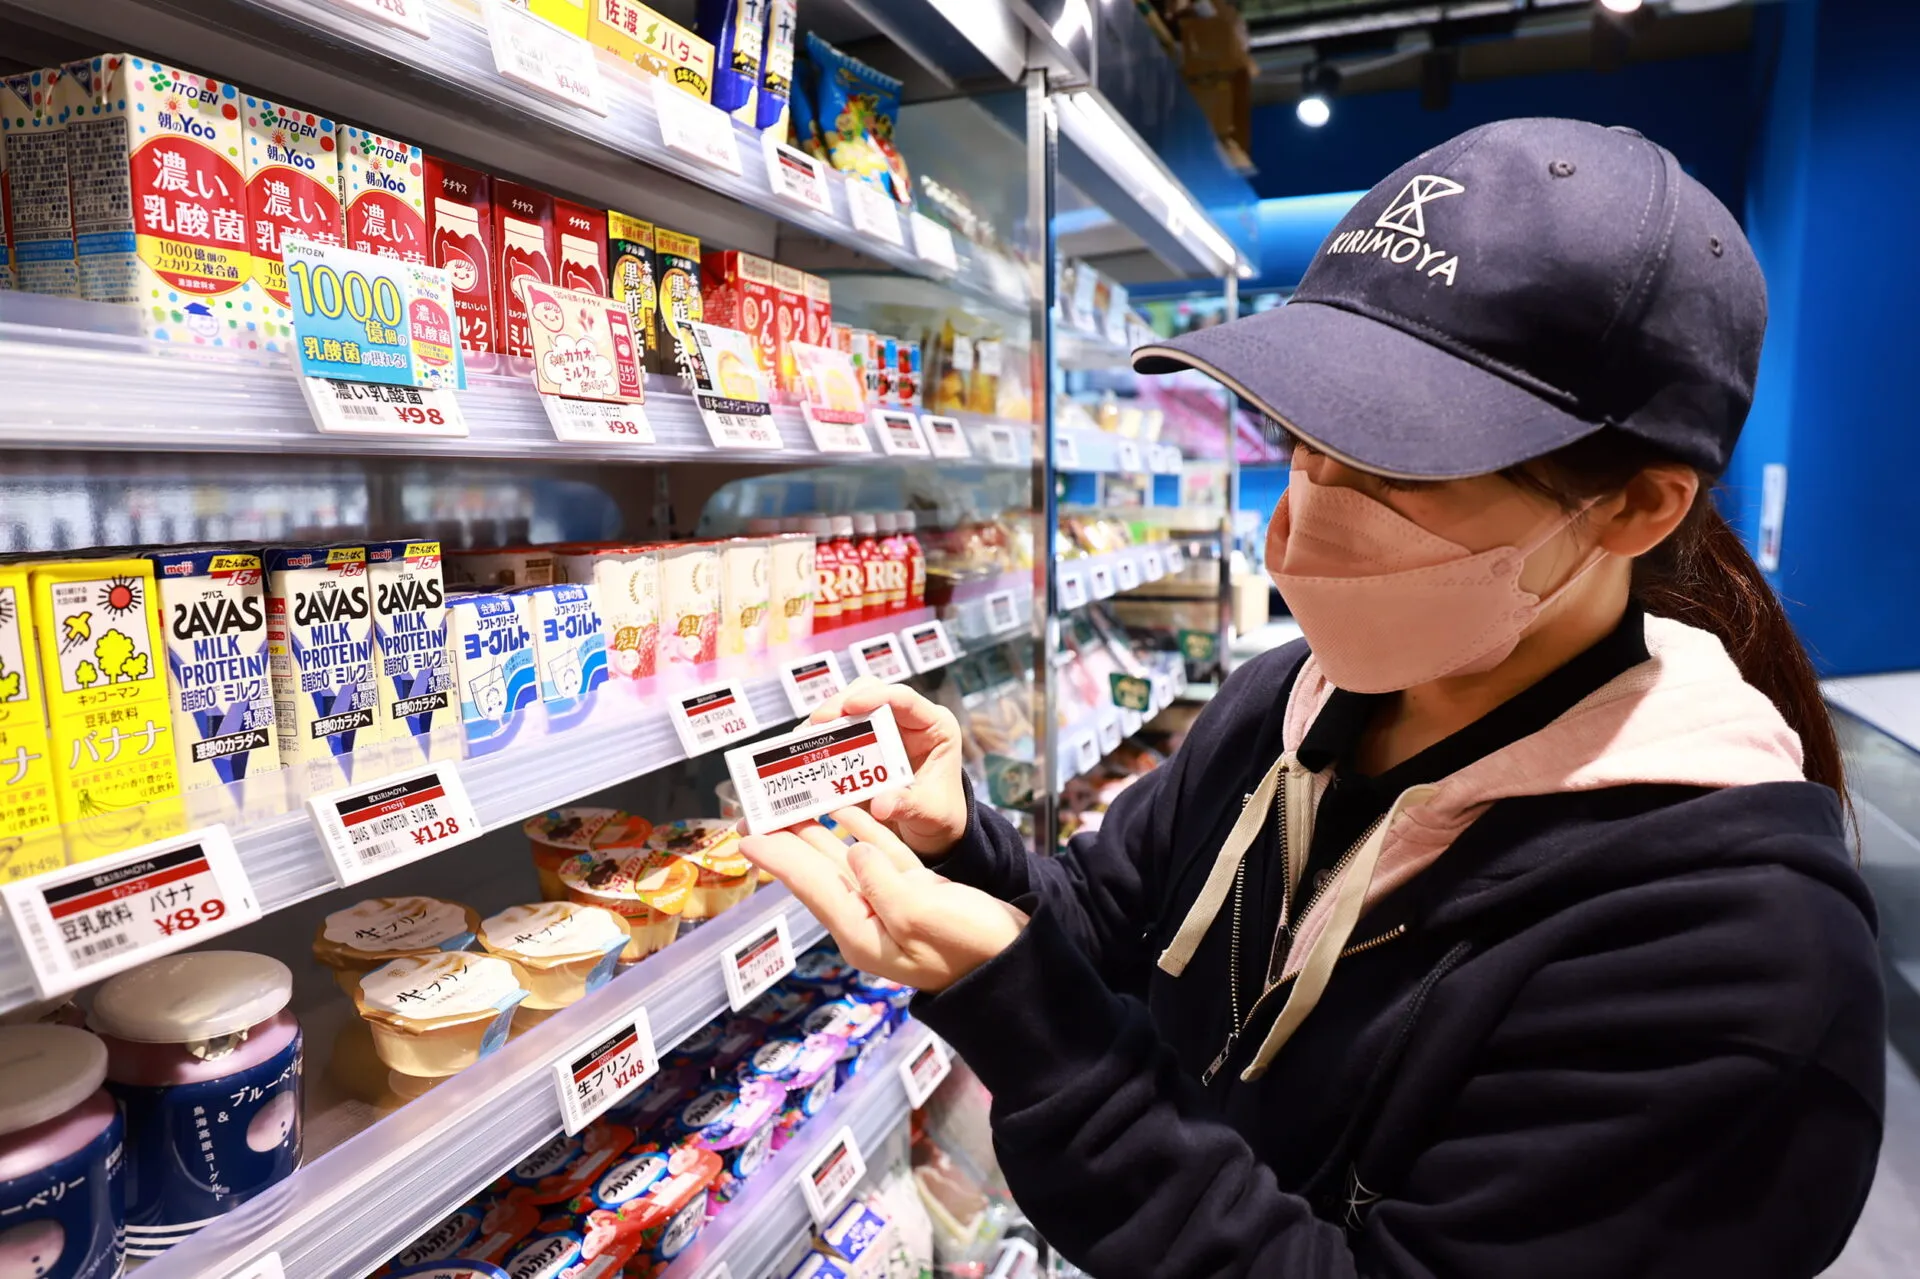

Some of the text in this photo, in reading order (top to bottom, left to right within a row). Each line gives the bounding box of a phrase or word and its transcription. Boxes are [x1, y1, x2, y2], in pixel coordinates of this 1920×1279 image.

[152, 147, 230, 200] 濃い
[263, 177, 327, 224] 濃い
[142, 194, 246, 244] 乳酸菌
[362, 201, 415, 243] 濃い
[160, 241, 227, 263] 1000億個の
[1327, 229, 1458, 286] KIRIMOYA
[289, 260, 403, 327] 1000
[394, 406, 445, 426] ¥98
[606, 419, 639, 435] ¥98
[164, 560, 194, 576] meiji
[288, 555, 313, 567] meiji
[370, 549, 393, 560] meiji
[294, 587, 369, 627] SAVAS
[378, 578, 443, 615] SAVAS
[173, 596, 263, 640] SAVAS
[393, 611, 428, 634] MILK
[543, 612, 602, 643] ヨーグルト
[193, 634, 241, 662] MILK
[311, 622, 351, 647] MILK
[384, 629, 443, 657] PROTEIN
[464, 625, 530, 660] ヨーグルト
[302, 641, 369, 671] PROTEIN
[182, 655, 263, 689] PROTEIN
[78, 686, 141, 706] キッコーマン
[85, 706, 139, 729] 豆乳飲料
[68, 720, 168, 770] バナナ
[195, 733, 267, 760] 理想のカラダへ
[796, 736, 835, 752] KIRIMOYA
[764, 753, 865, 796] ソフトクリーミーヨーグルト プレーン
[831, 765, 888, 795] ¥150
[381, 800, 406, 814] meiji
[410, 817, 460, 845] ¥128
[59, 903, 133, 943] 豆乳飲料
[150, 882, 195, 912] バナナ
[155, 899, 226, 936] ¥89
[577, 1053, 632, 1099] 生プリン
[614, 1060, 645, 1089] ¥148
[217, 1111, 230, 1124] &
[603, 1157, 651, 1198] ブルガリア
[402, 1213, 465, 1264] ブルガリア
